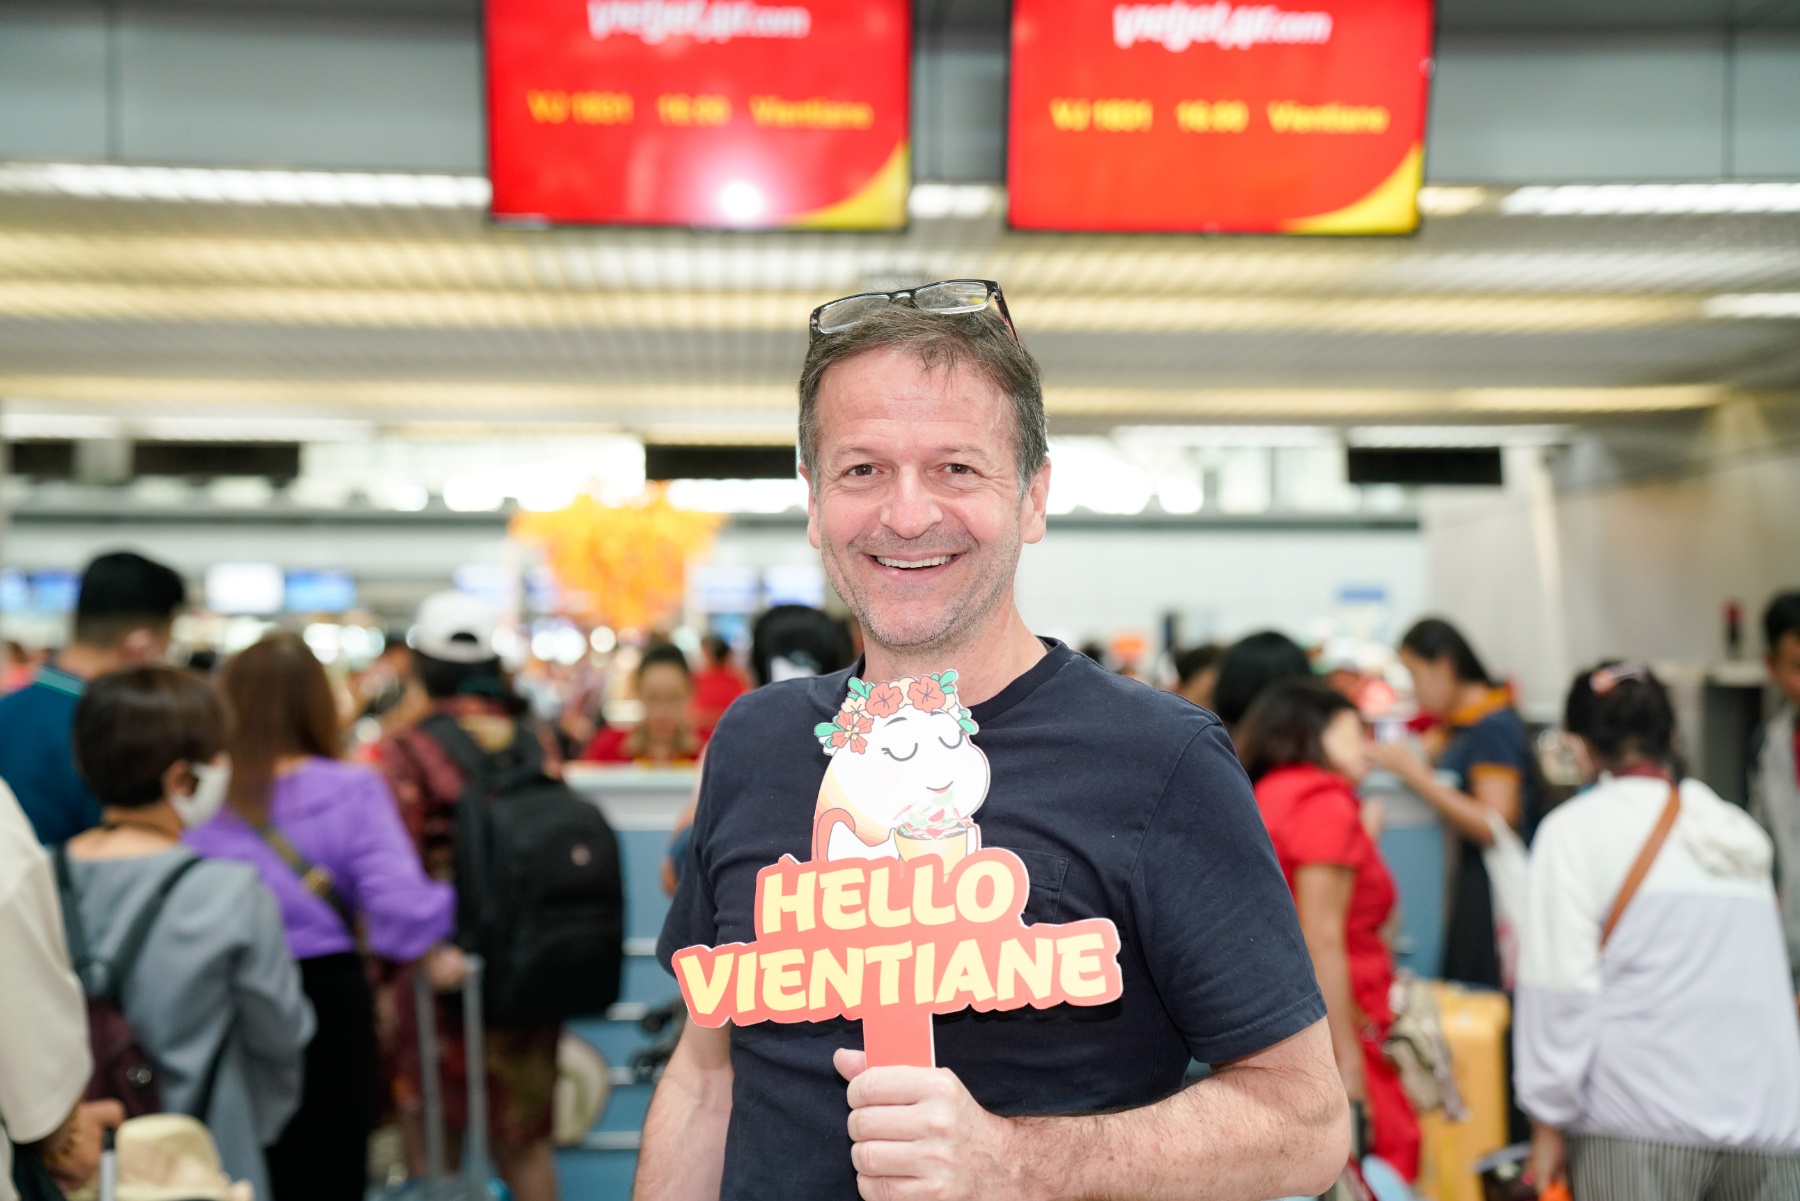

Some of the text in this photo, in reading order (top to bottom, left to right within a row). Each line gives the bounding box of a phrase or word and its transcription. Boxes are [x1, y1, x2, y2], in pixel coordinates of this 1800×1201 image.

[749, 95, 876, 130] Vientiane
[1267, 100, 1390, 134] Vientiane
[762, 860, 1015, 934] HELLO
[679, 933, 1107, 1015] VIENTIANE
